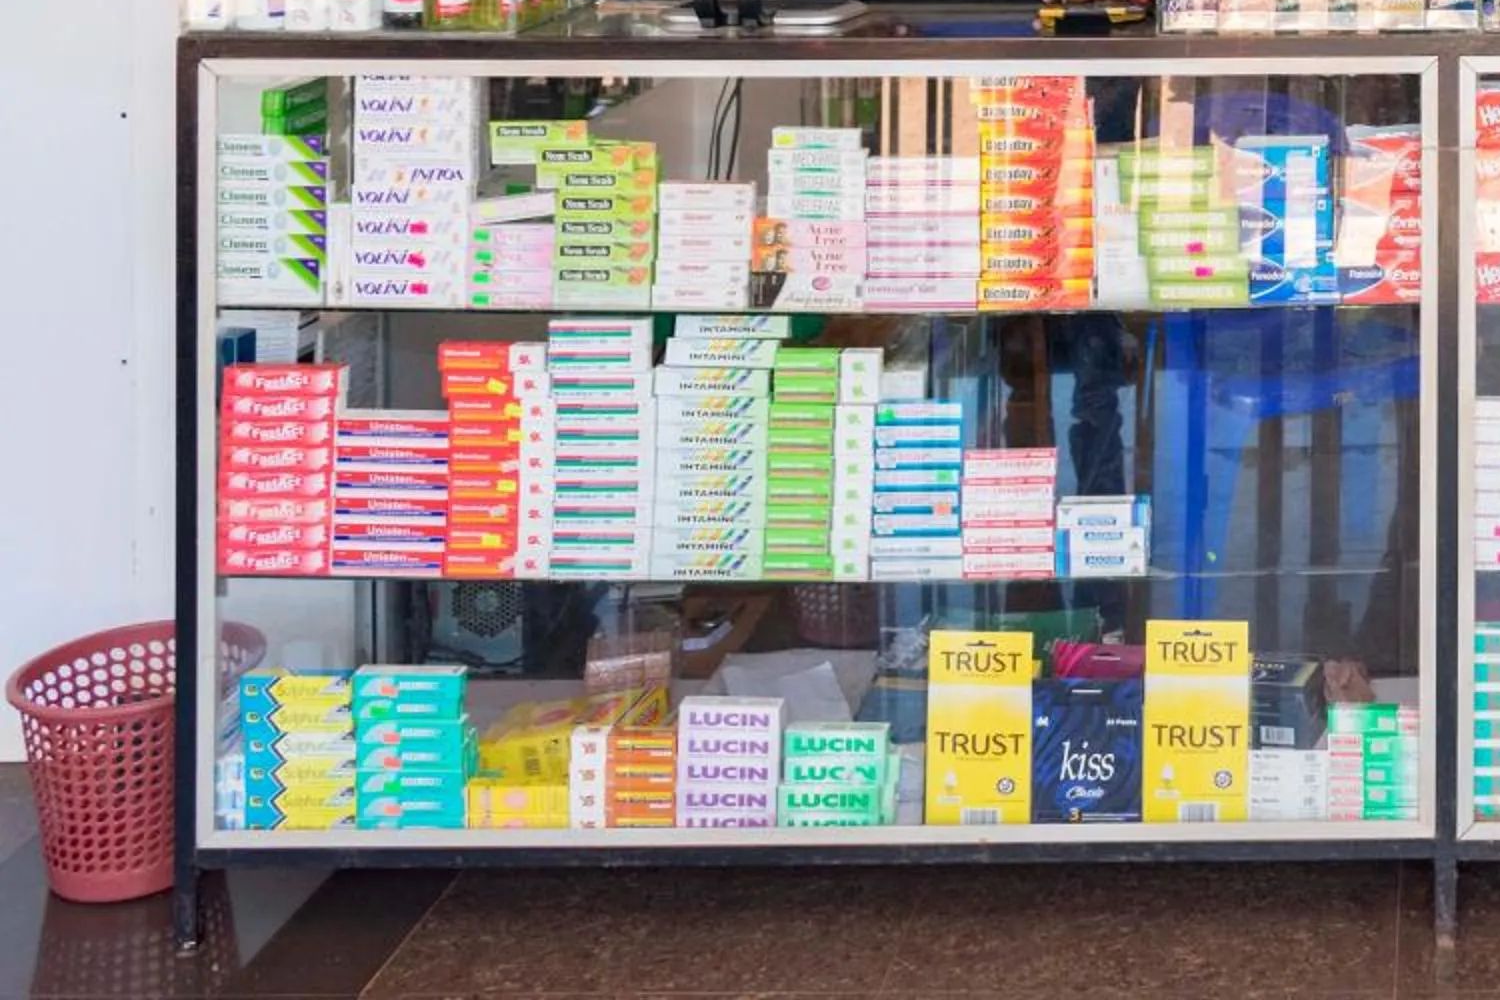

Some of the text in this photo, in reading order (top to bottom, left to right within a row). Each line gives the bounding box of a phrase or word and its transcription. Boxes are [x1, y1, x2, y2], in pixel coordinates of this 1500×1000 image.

[1157, 641, 1238, 663] TRUST
[940, 651, 1023, 673] TRUST
[689, 712, 770, 726] LUCIN
[935, 731, 1025, 756] TRUST
[1151, 724, 1243, 748] TRUST
[688, 739, 769, 754] LUCIN
[793, 737, 875, 752] LUCIN
[1059, 740, 1116, 781] kiss
[687, 766, 768, 780] LUCIN
[794, 766, 876, 781] LUCN
[686, 793, 767, 807] LUCIN
[787, 793, 870, 807] LUCIN
